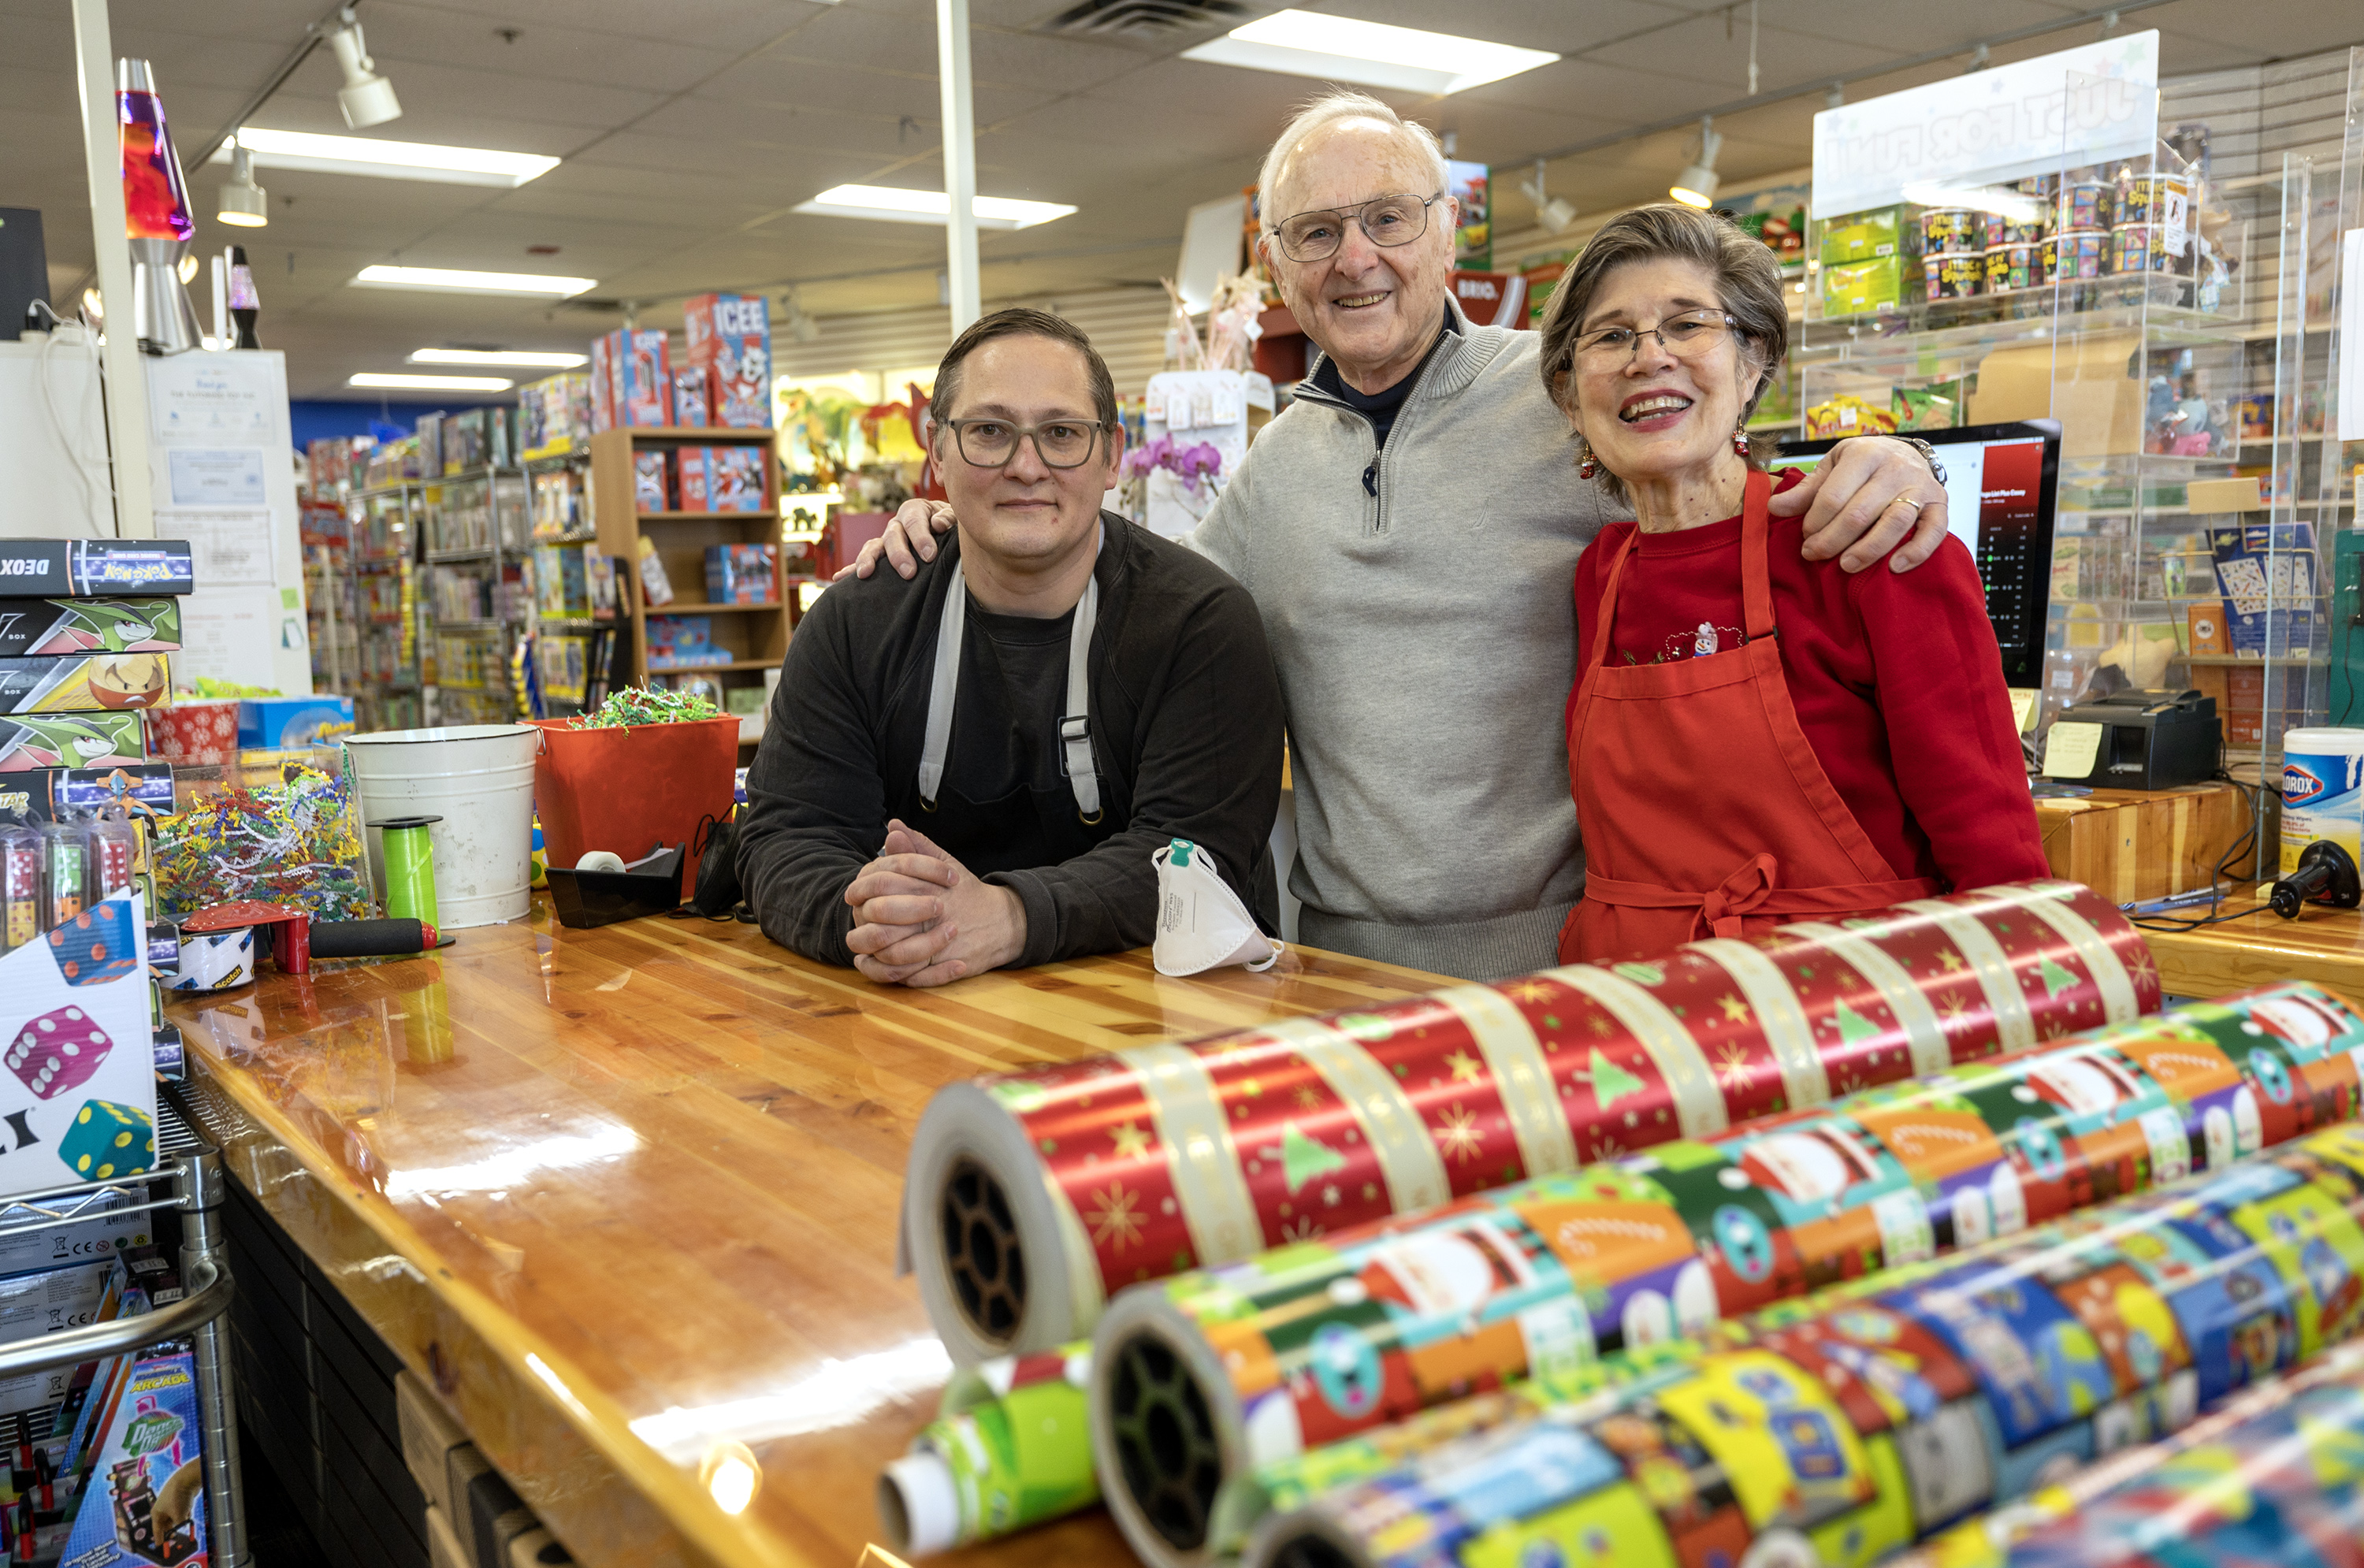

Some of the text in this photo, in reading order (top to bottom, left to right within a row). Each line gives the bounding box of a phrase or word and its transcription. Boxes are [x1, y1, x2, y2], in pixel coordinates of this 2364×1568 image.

[712, 301, 764, 335] ICEE
[214, 966, 243, 989] Scotch
[129, 1373, 191, 1393] ARCADE
